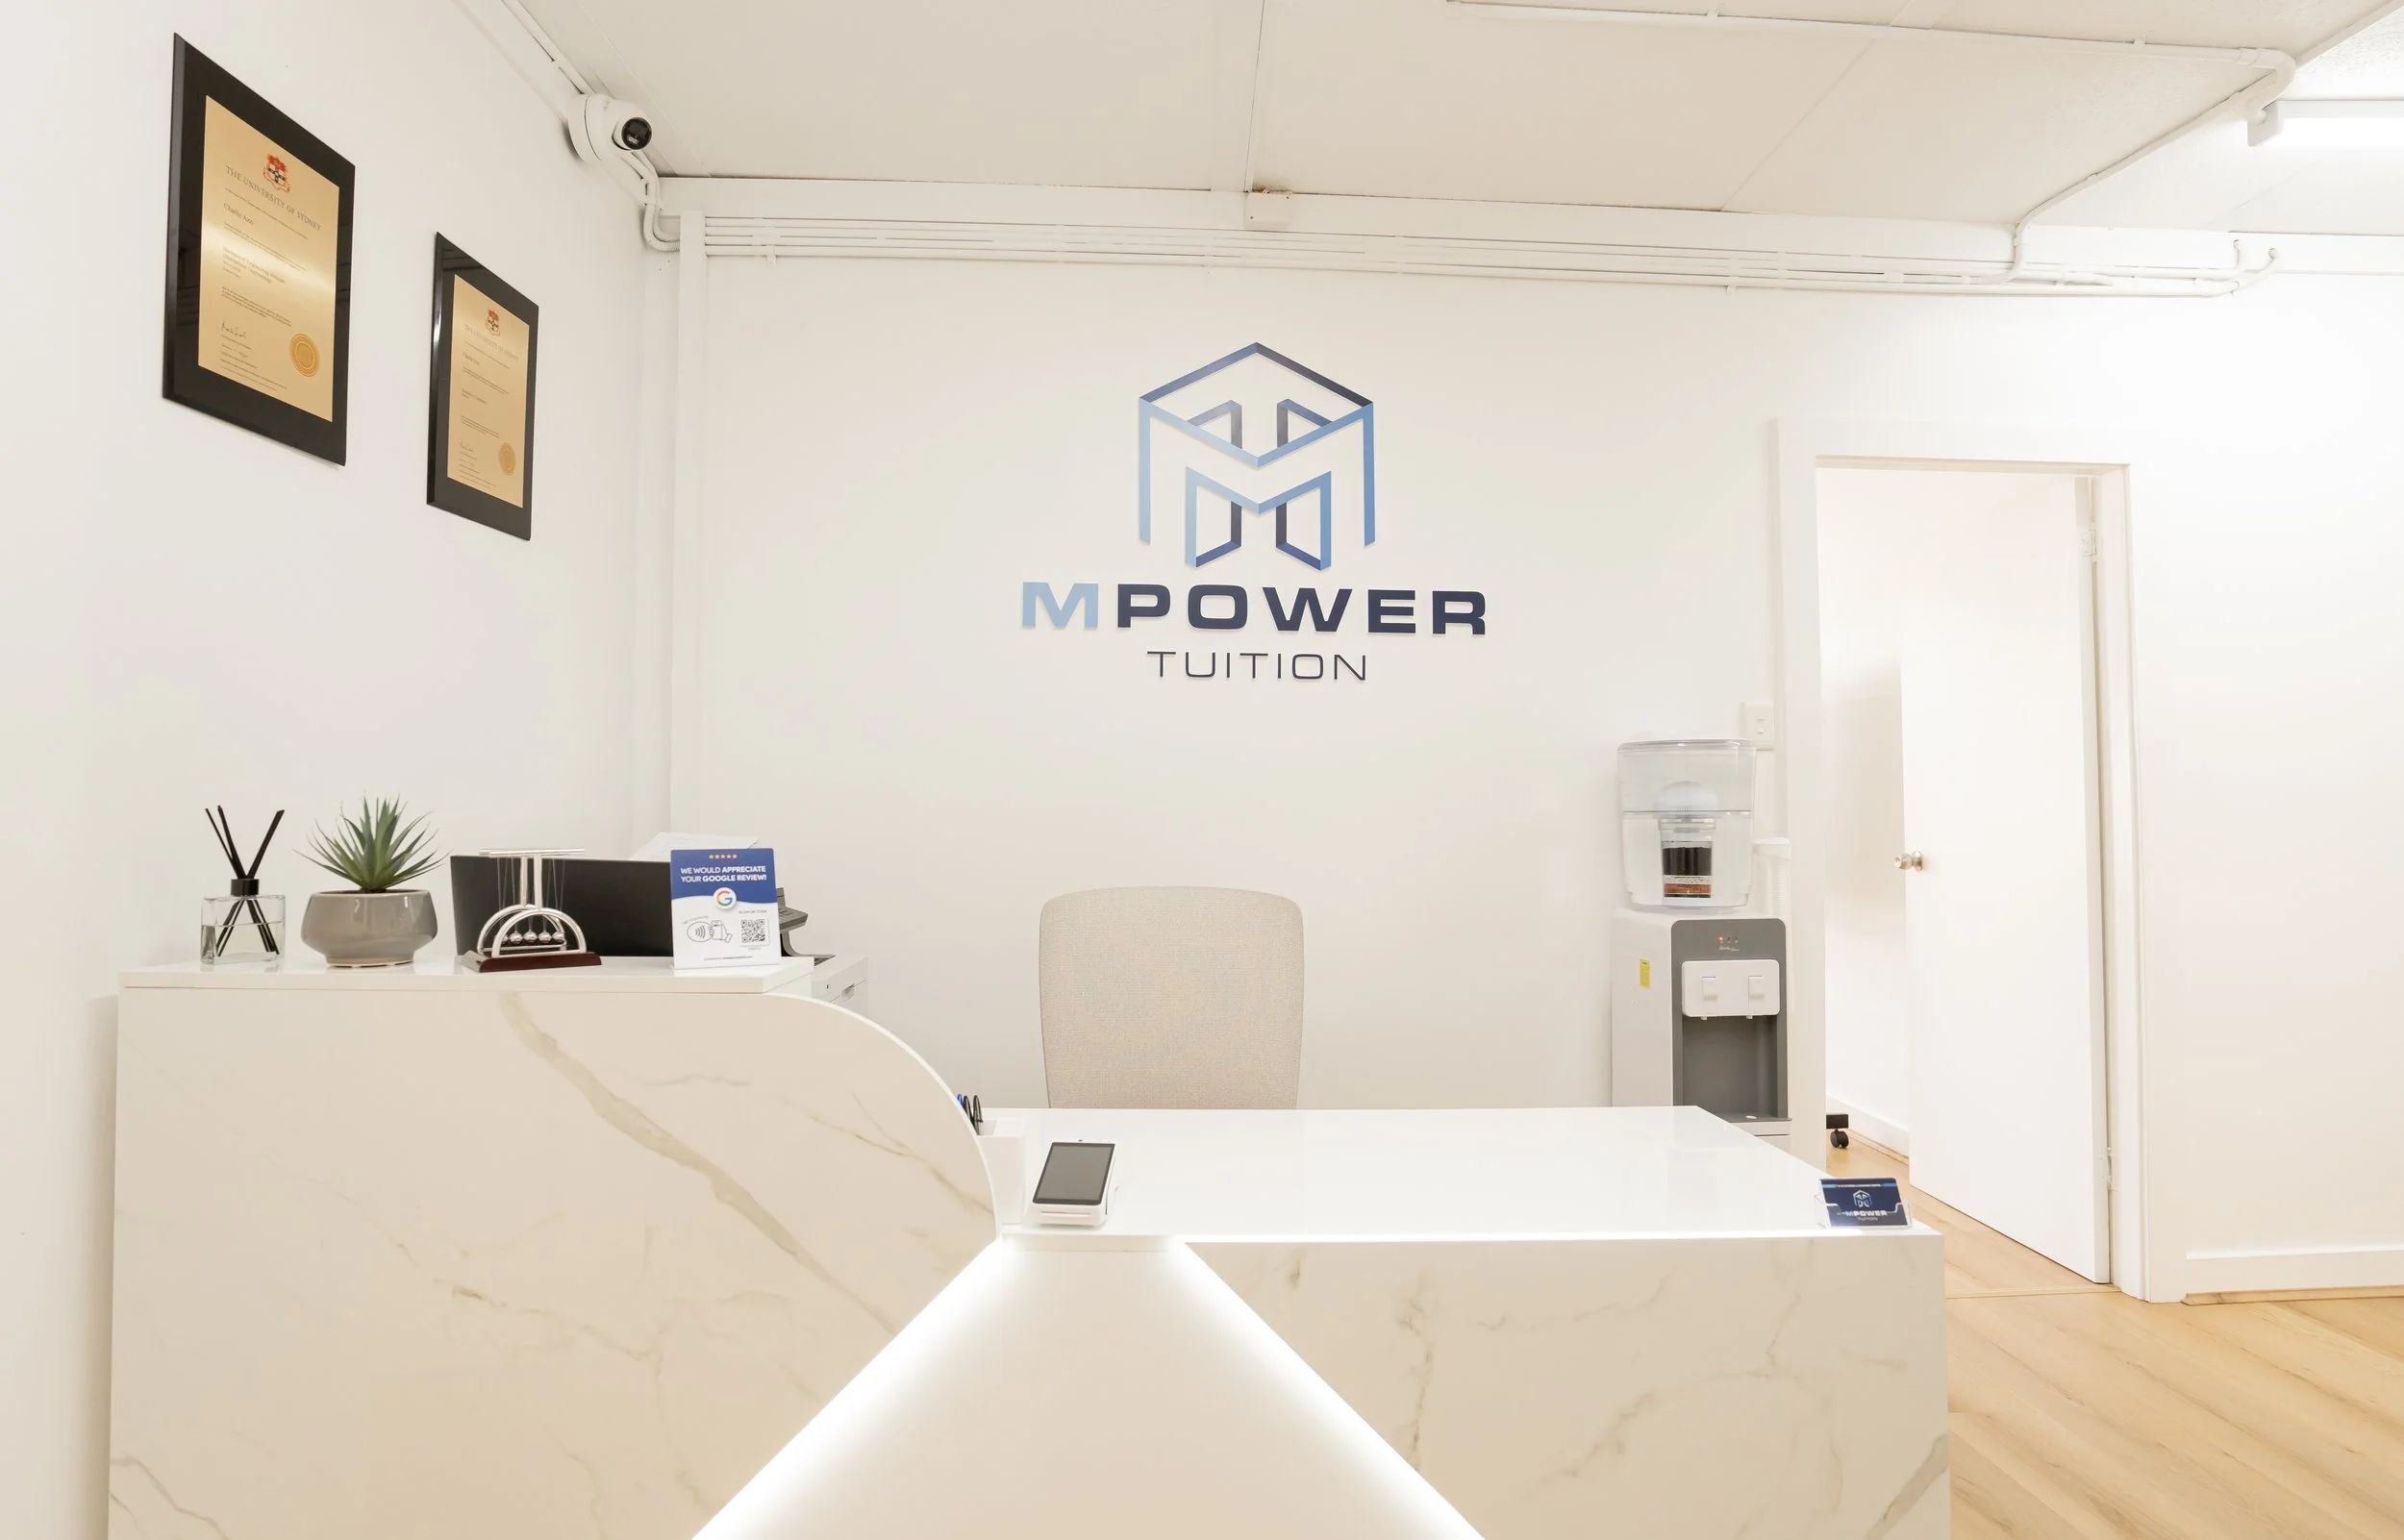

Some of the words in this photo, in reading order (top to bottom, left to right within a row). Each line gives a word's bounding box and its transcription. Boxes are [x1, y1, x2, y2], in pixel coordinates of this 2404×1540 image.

[225, 164, 242, 182] THE
[242, 176, 286, 209] UNIVERSITY
[286, 204, 296, 214] OF
[296, 211, 322, 232] SYDNEY
[1022, 582, 1487, 635] MPOWER
[1147, 651, 1366, 682] TUITION
[693, 866, 721, 875] WOULD
[722, 865, 766, 874] APPRECIATE
